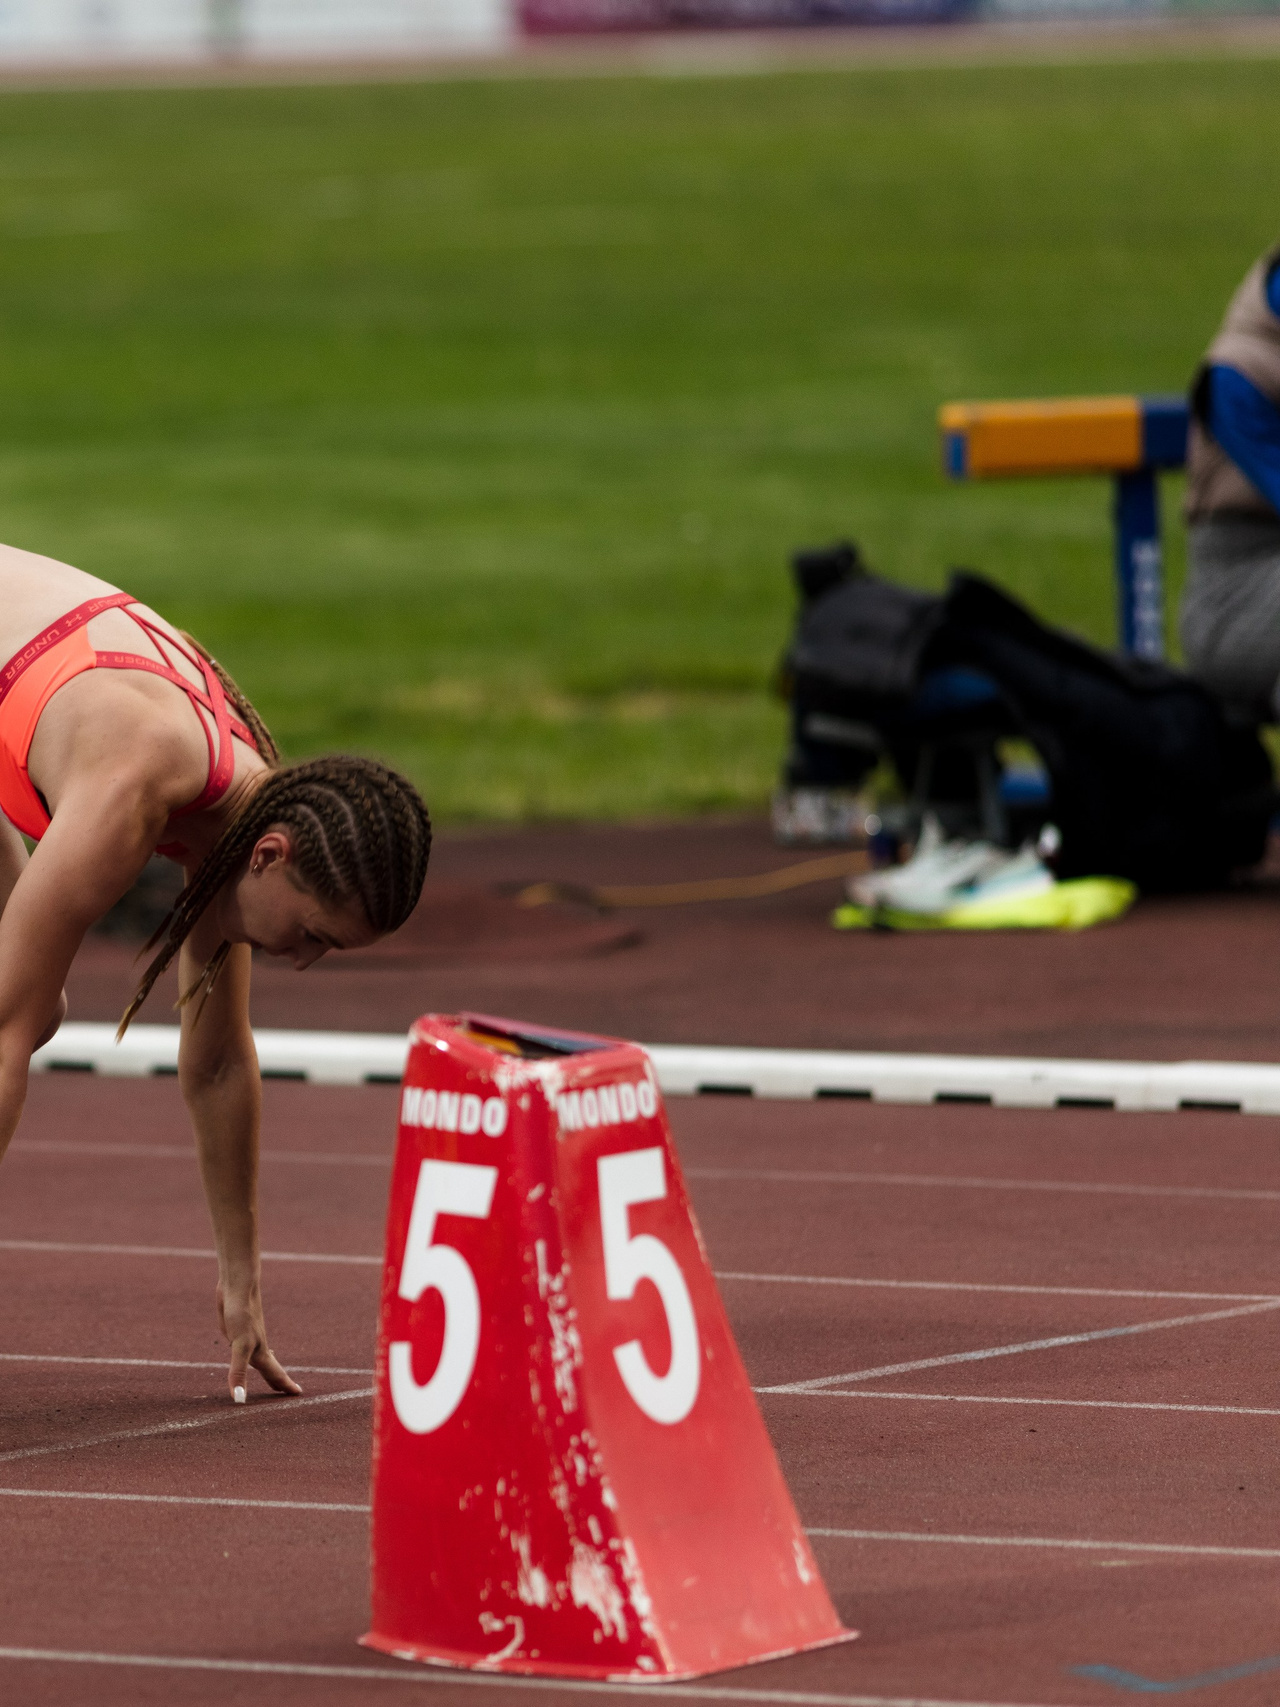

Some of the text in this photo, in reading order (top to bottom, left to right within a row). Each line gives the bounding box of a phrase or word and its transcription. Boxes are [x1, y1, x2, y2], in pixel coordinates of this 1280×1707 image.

[5, 629, 60, 680] UNDER
[114, 655, 166, 673] UNDER
[401, 1086, 508, 1137] MONDO
[558, 1081, 658, 1131] MONDO
[389, 1158, 498, 1435] 5
[597, 1147, 700, 1424] 5
